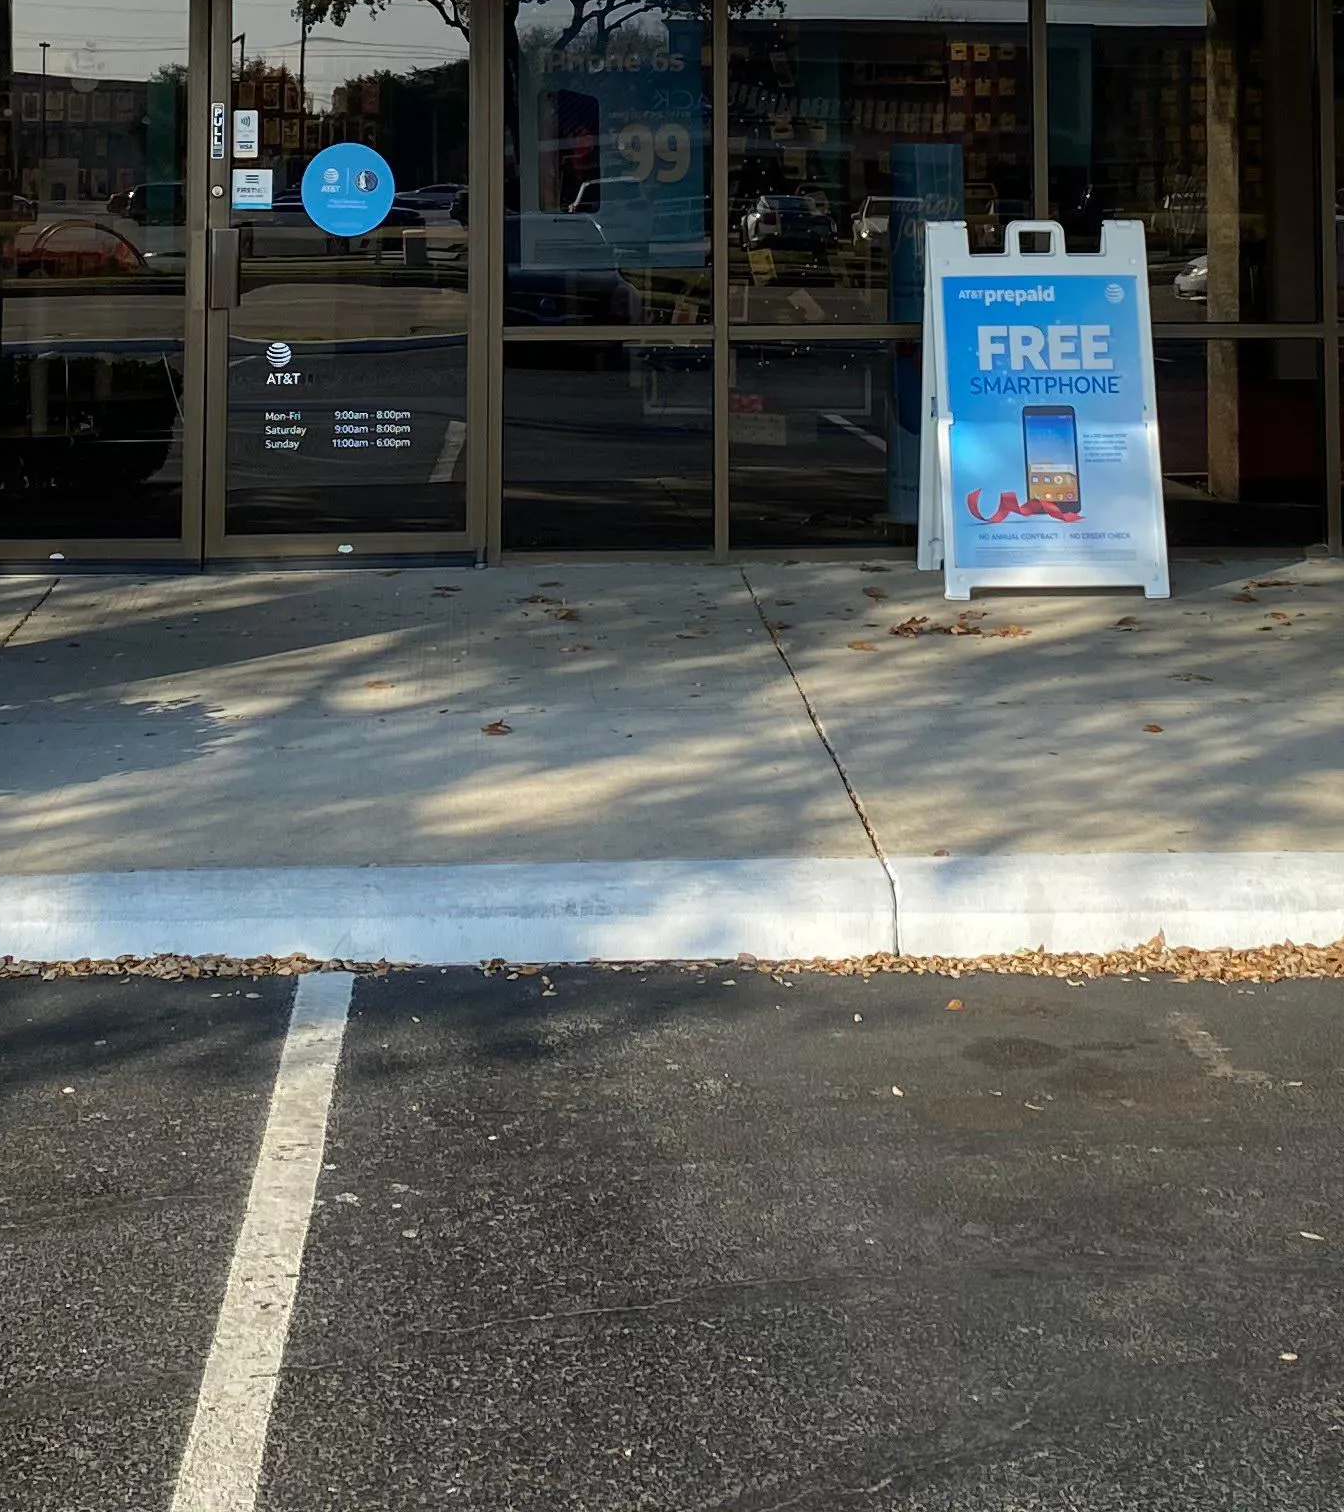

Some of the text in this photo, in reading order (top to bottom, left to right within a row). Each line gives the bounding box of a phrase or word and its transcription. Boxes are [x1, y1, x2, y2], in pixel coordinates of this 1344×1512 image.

[213, 107, 223, 145] PULL
[984, 284, 1056, 307] prepaid
[976, 324, 1114, 371] FREE
[266, 372, 302, 385] AT&T
[970, 375, 1122, 395] SMARTPHONE
[265, 411, 302, 421] Mon-Fri
[334, 411, 369, 420] 9:00am
[376, 410, 411, 421] 8:00pm
[265, 425, 307, 436] Saturday
[334, 425, 369, 433] 9:00am
[376, 424, 411, 435] 8:00pm
[265, 438, 300, 450] Sunday
[332, 438, 369, 447] 11:00am
[376, 437, 411, 448] 6:00pm
